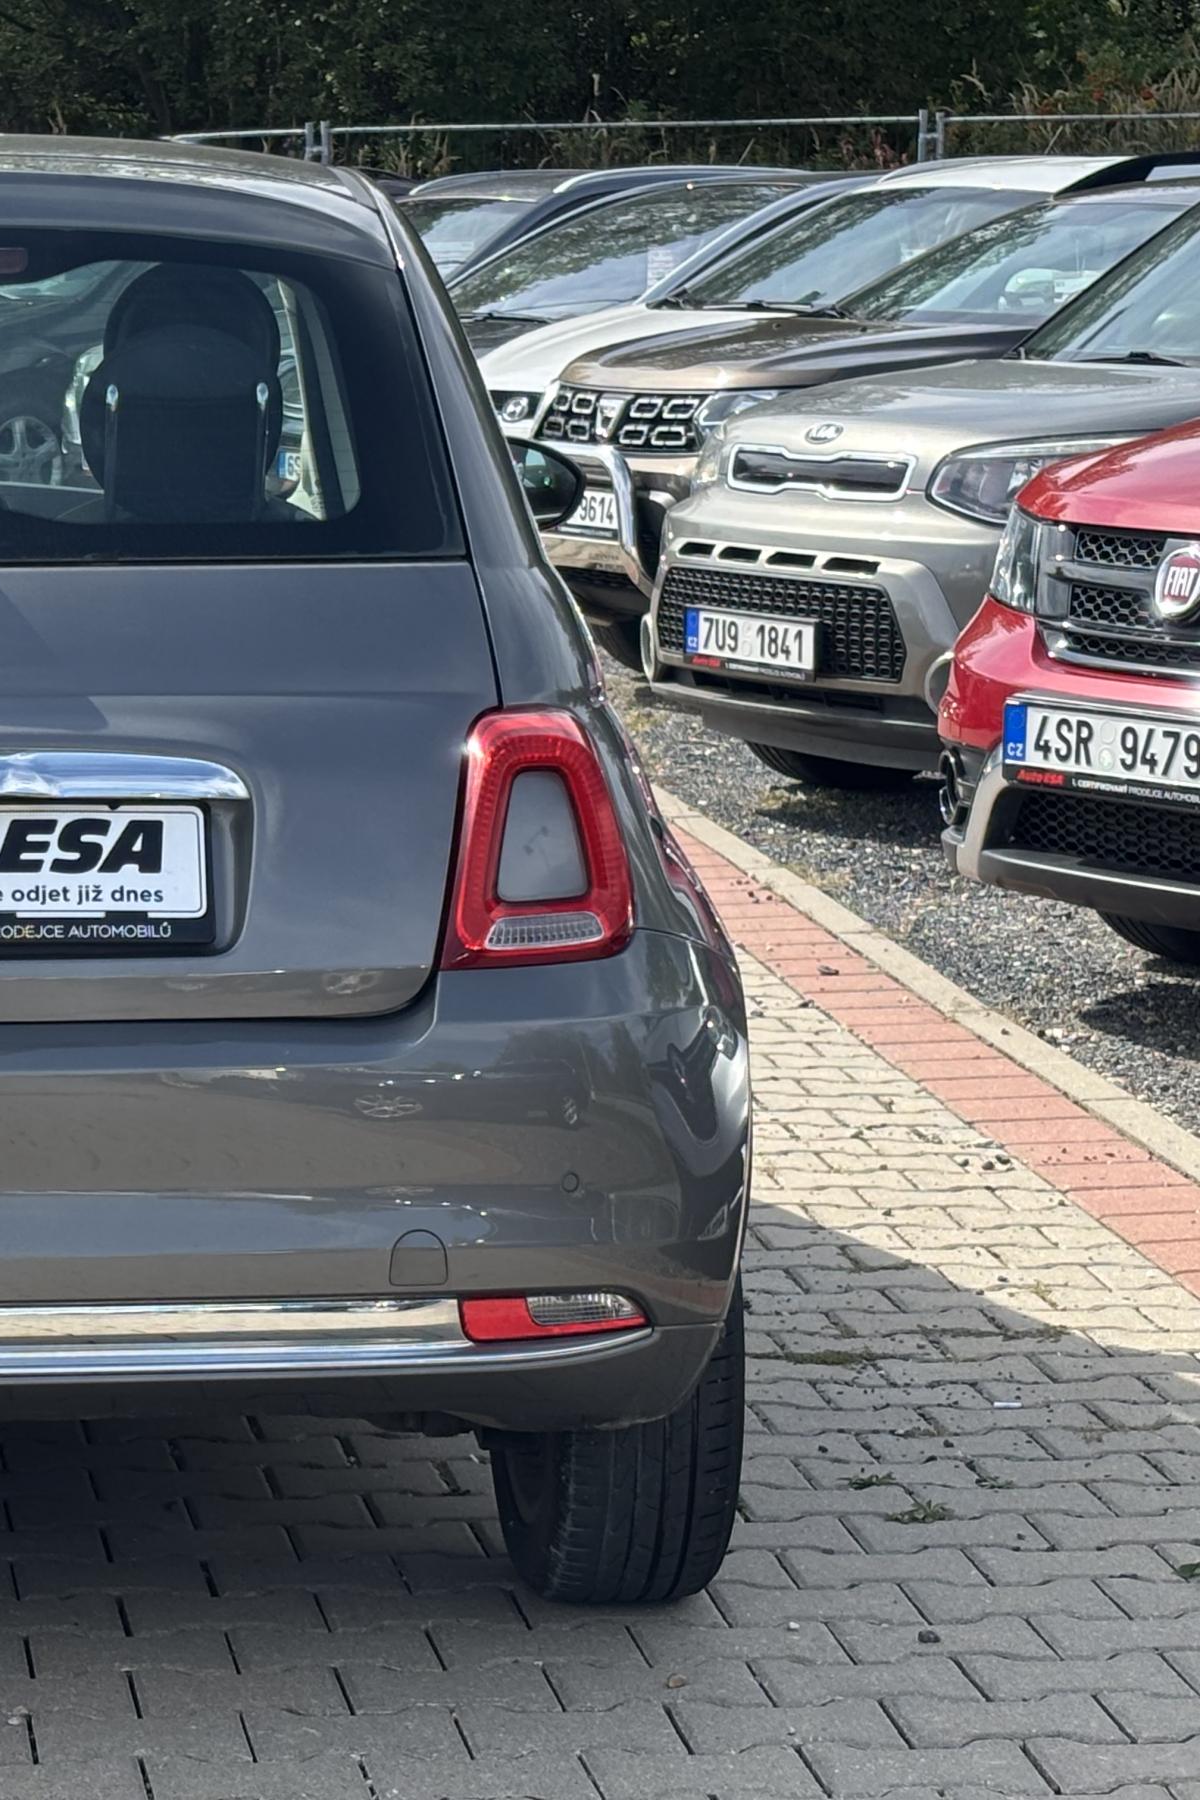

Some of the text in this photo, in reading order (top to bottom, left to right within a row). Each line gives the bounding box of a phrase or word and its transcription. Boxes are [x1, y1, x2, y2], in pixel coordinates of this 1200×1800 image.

[579, 495, 615, 525] 9614
[1164, 566, 1198, 597] FIAT
[703, 617, 804, 663] 7U9 1841
[1007, 742, 1024, 758] CZ
[1034, 715, 1200, 780] 4SR 9479
[11, 885, 70, 905] odjet
[77, 885, 103, 905] již
[111, 885, 164, 903] dnes
